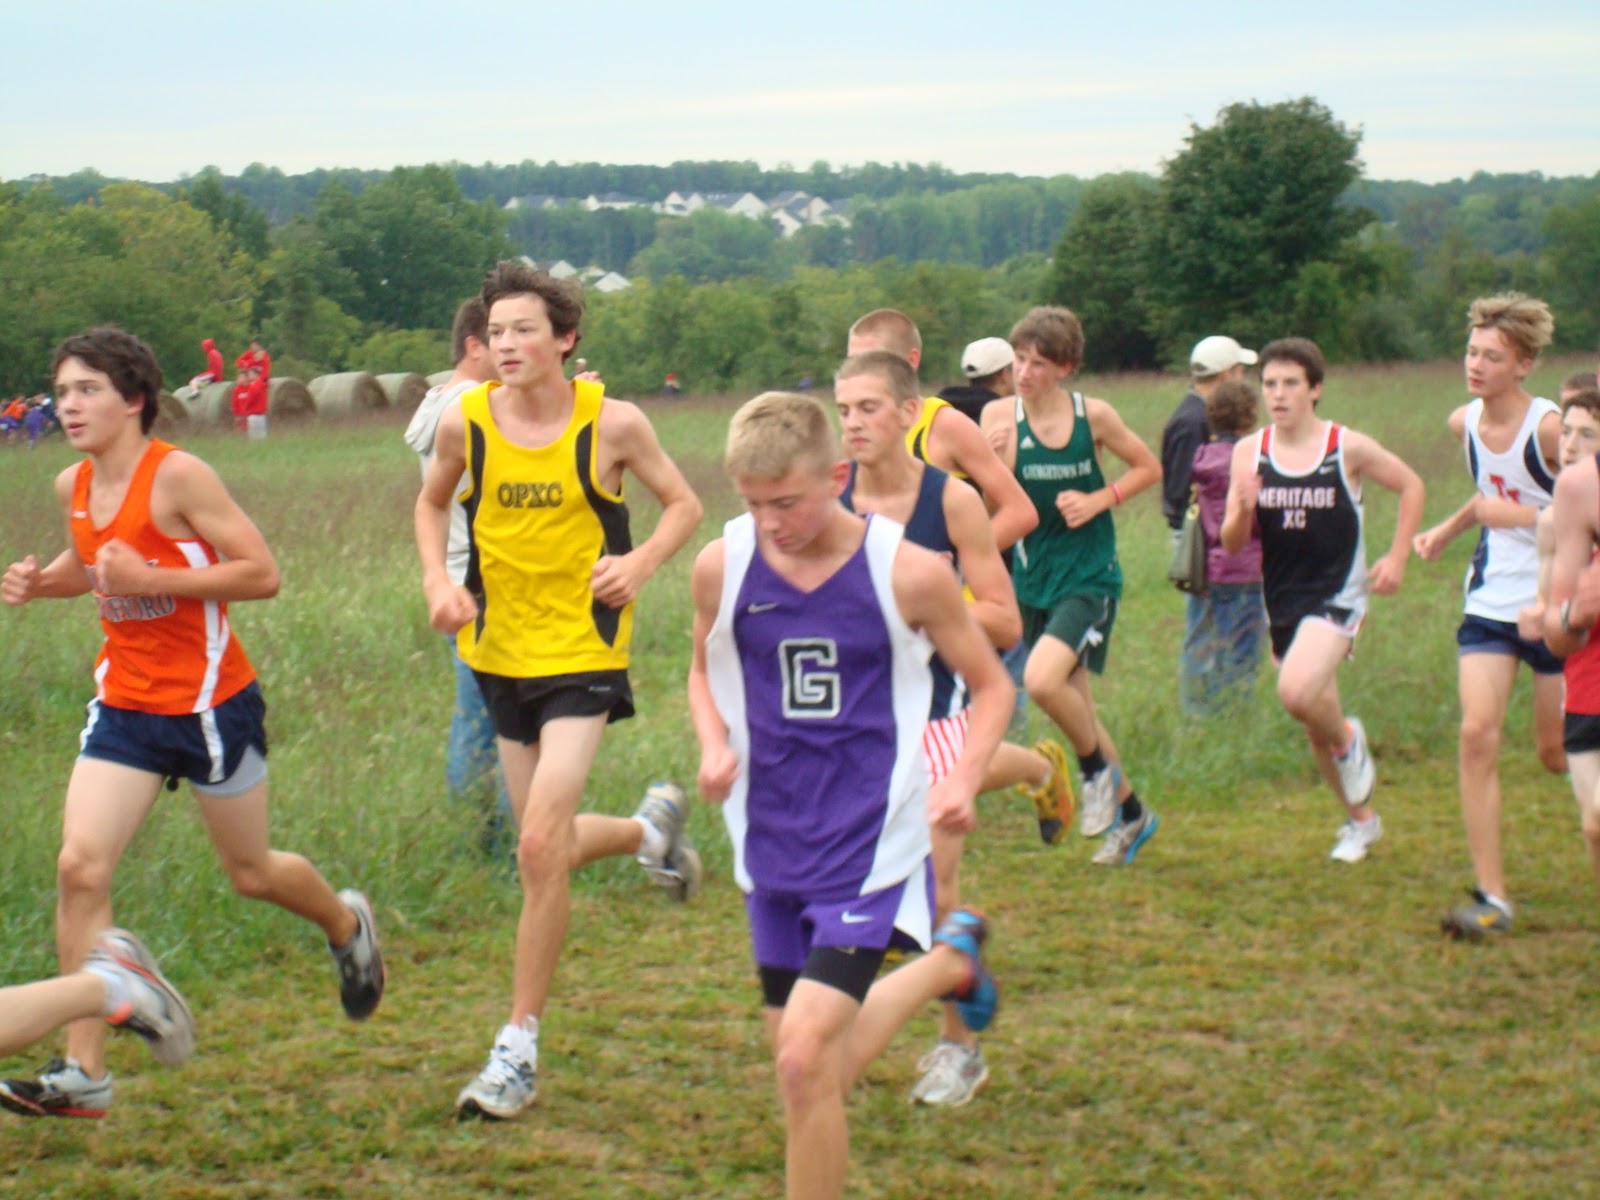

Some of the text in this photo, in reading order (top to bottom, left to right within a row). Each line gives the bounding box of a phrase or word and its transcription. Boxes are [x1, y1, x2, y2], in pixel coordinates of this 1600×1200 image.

[497, 482, 563, 508] OPXC
[1258, 486, 1336, 509] HERITAGE
[1282, 508, 1307, 530] XC
[778, 637, 841, 719] G
